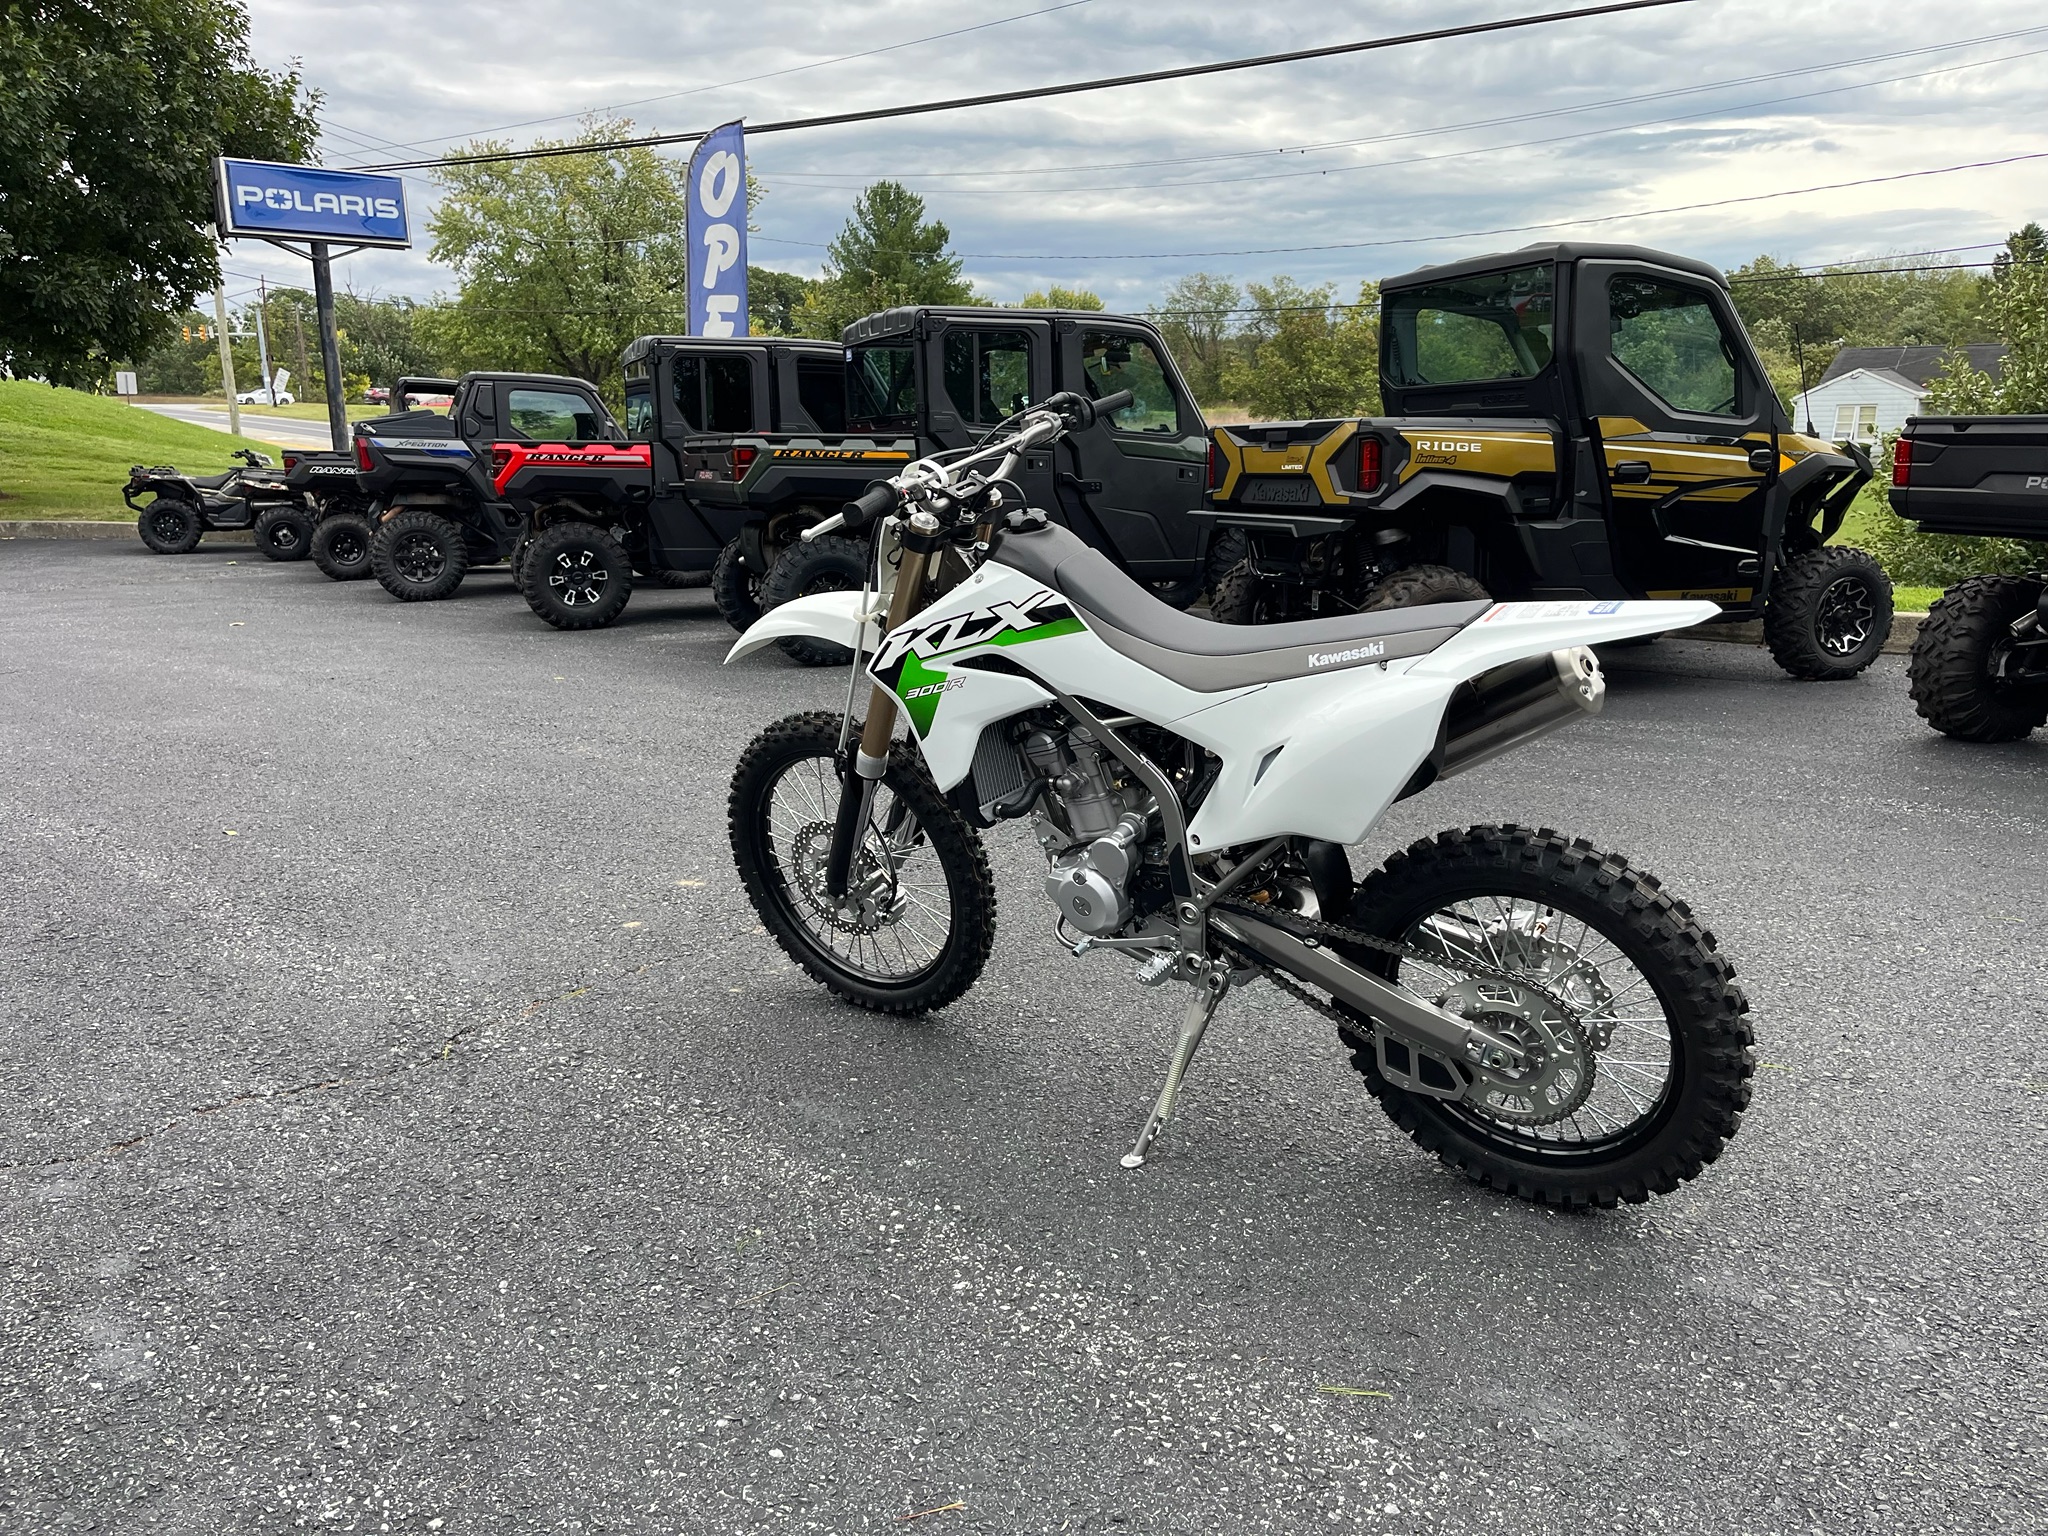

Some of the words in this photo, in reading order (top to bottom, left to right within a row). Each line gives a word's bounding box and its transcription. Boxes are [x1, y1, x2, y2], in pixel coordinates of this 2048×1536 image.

[236, 185, 400, 219] POLARIS
[394, 439, 449, 448] XPEDITION
[1416, 440, 1482, 453] RIDGE
[529, 453, 605, 462] RANGER
[777, 450, 865, 459] RANGER
[1415, 453, 1457, 465] Inline-4
[1252, 483, 1311, 503] Kawasaki
[1680, 589, 1738, 601] Kawasaki
[873, 590, 1056, 673] KLX
[1308, 641, 1384, 668] Kawasaki
[905, 676, 967, 700] 300R
